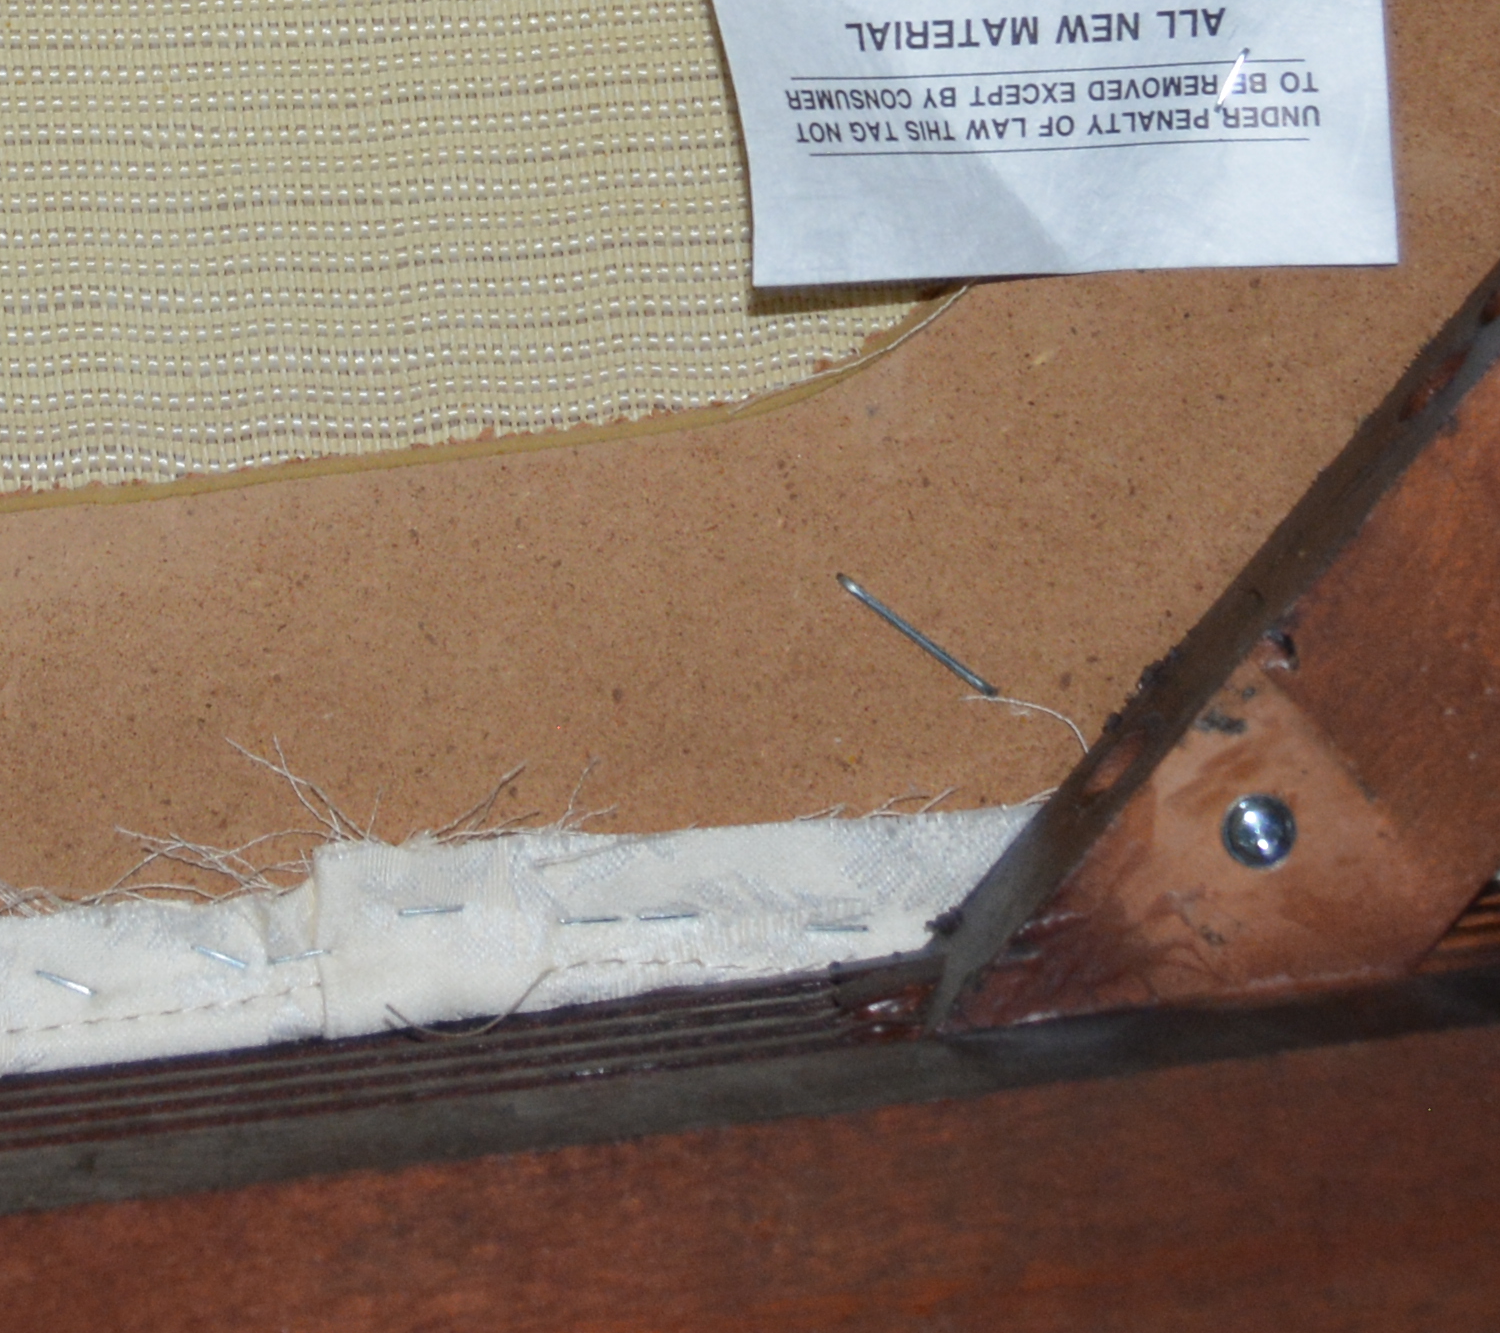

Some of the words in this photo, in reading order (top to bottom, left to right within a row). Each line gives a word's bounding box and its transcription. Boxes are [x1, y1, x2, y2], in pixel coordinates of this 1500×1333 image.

[843, 15, 1039, 52] MATERIAL
[1054, 11, 1140, 44] NEW
[1155, 6, 1226, 39] ALL
[968, 80, 1076, 107] EXCEPT
[1086, 73, 1218, 102] REMOVED
[1231, 70, 1267, 95] BE
[1279, 70, 1319, 94] TO
[784, 87, 912, 111] CONSUMER
[922, 85, 957, 109] BY
[964, 116, 1026, 141] LAW
[1037, 113, 1075, 138] OF
[1085, 106, 1210, 136] PENALTY
[1219, 102, 1321, 130] UNDER
[795, 121, 842, 144] NOT
[847, 120, 899, 143] TAG
[903, 119, 956, 142] THIS
